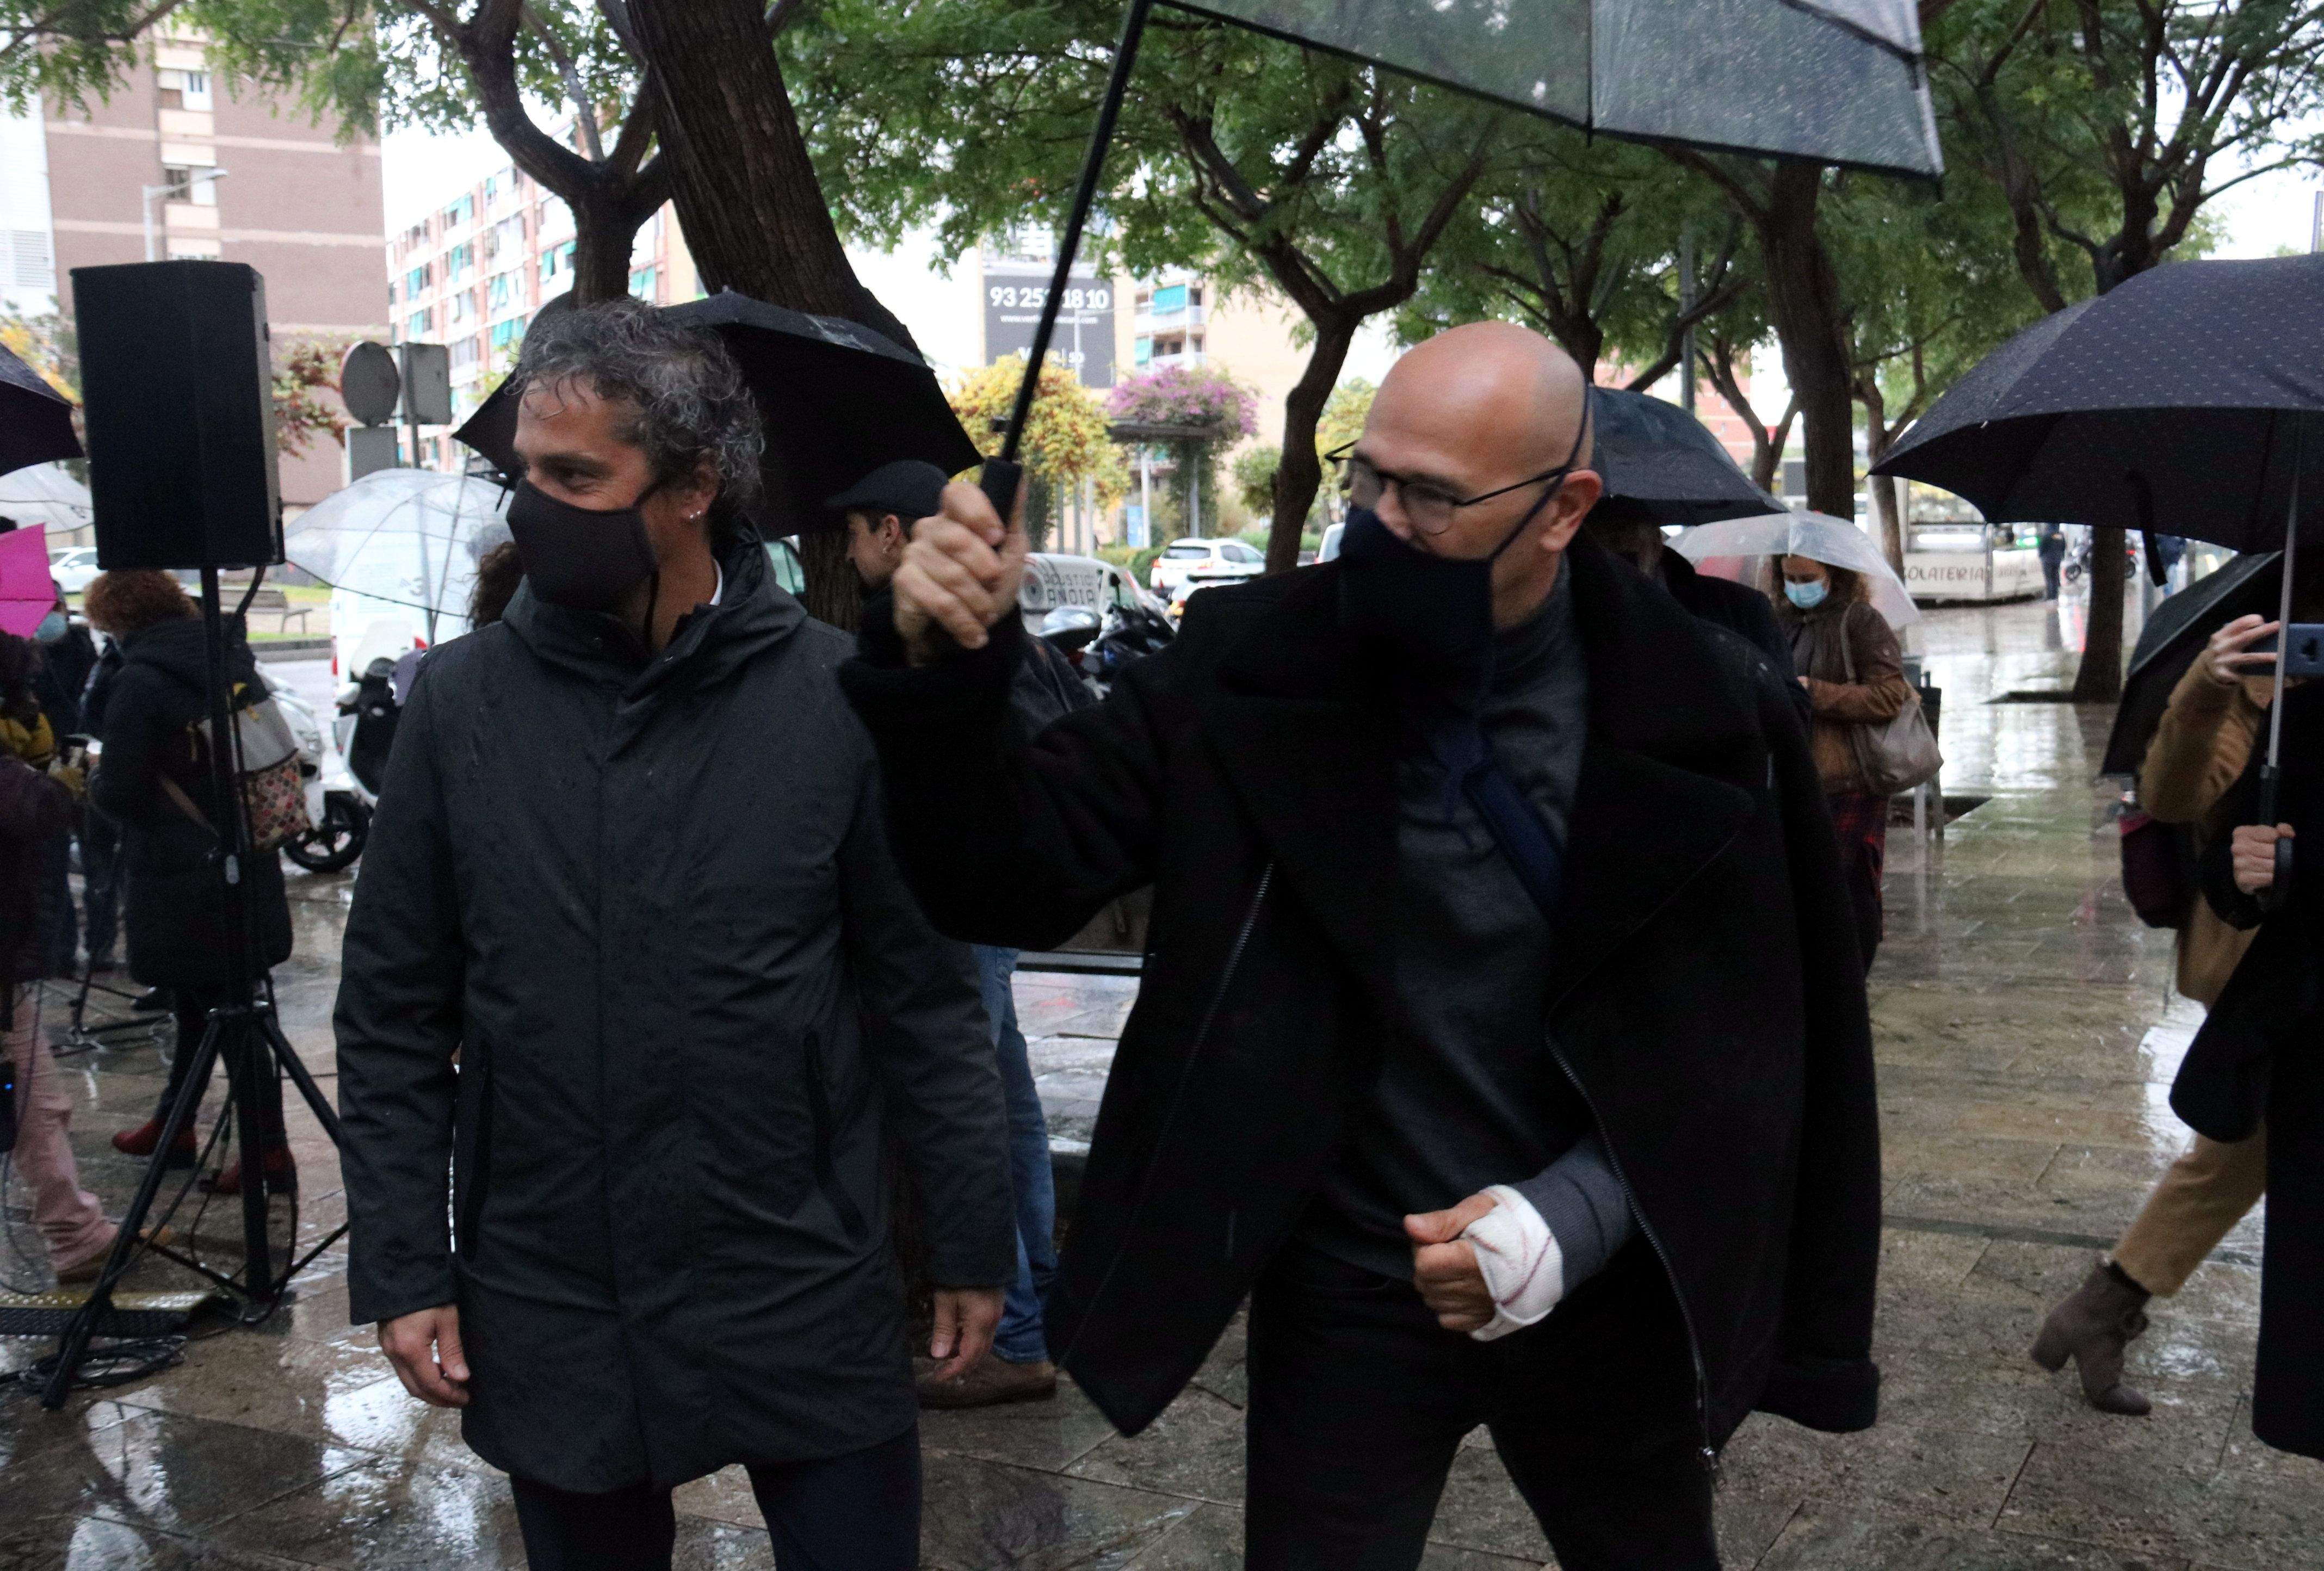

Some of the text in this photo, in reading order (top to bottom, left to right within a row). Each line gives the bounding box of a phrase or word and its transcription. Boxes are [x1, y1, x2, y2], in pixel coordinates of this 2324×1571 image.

[990, 286, 1109, 310] 93 25 18 10
[1903, 566, 1984, 582] OLATERIA
